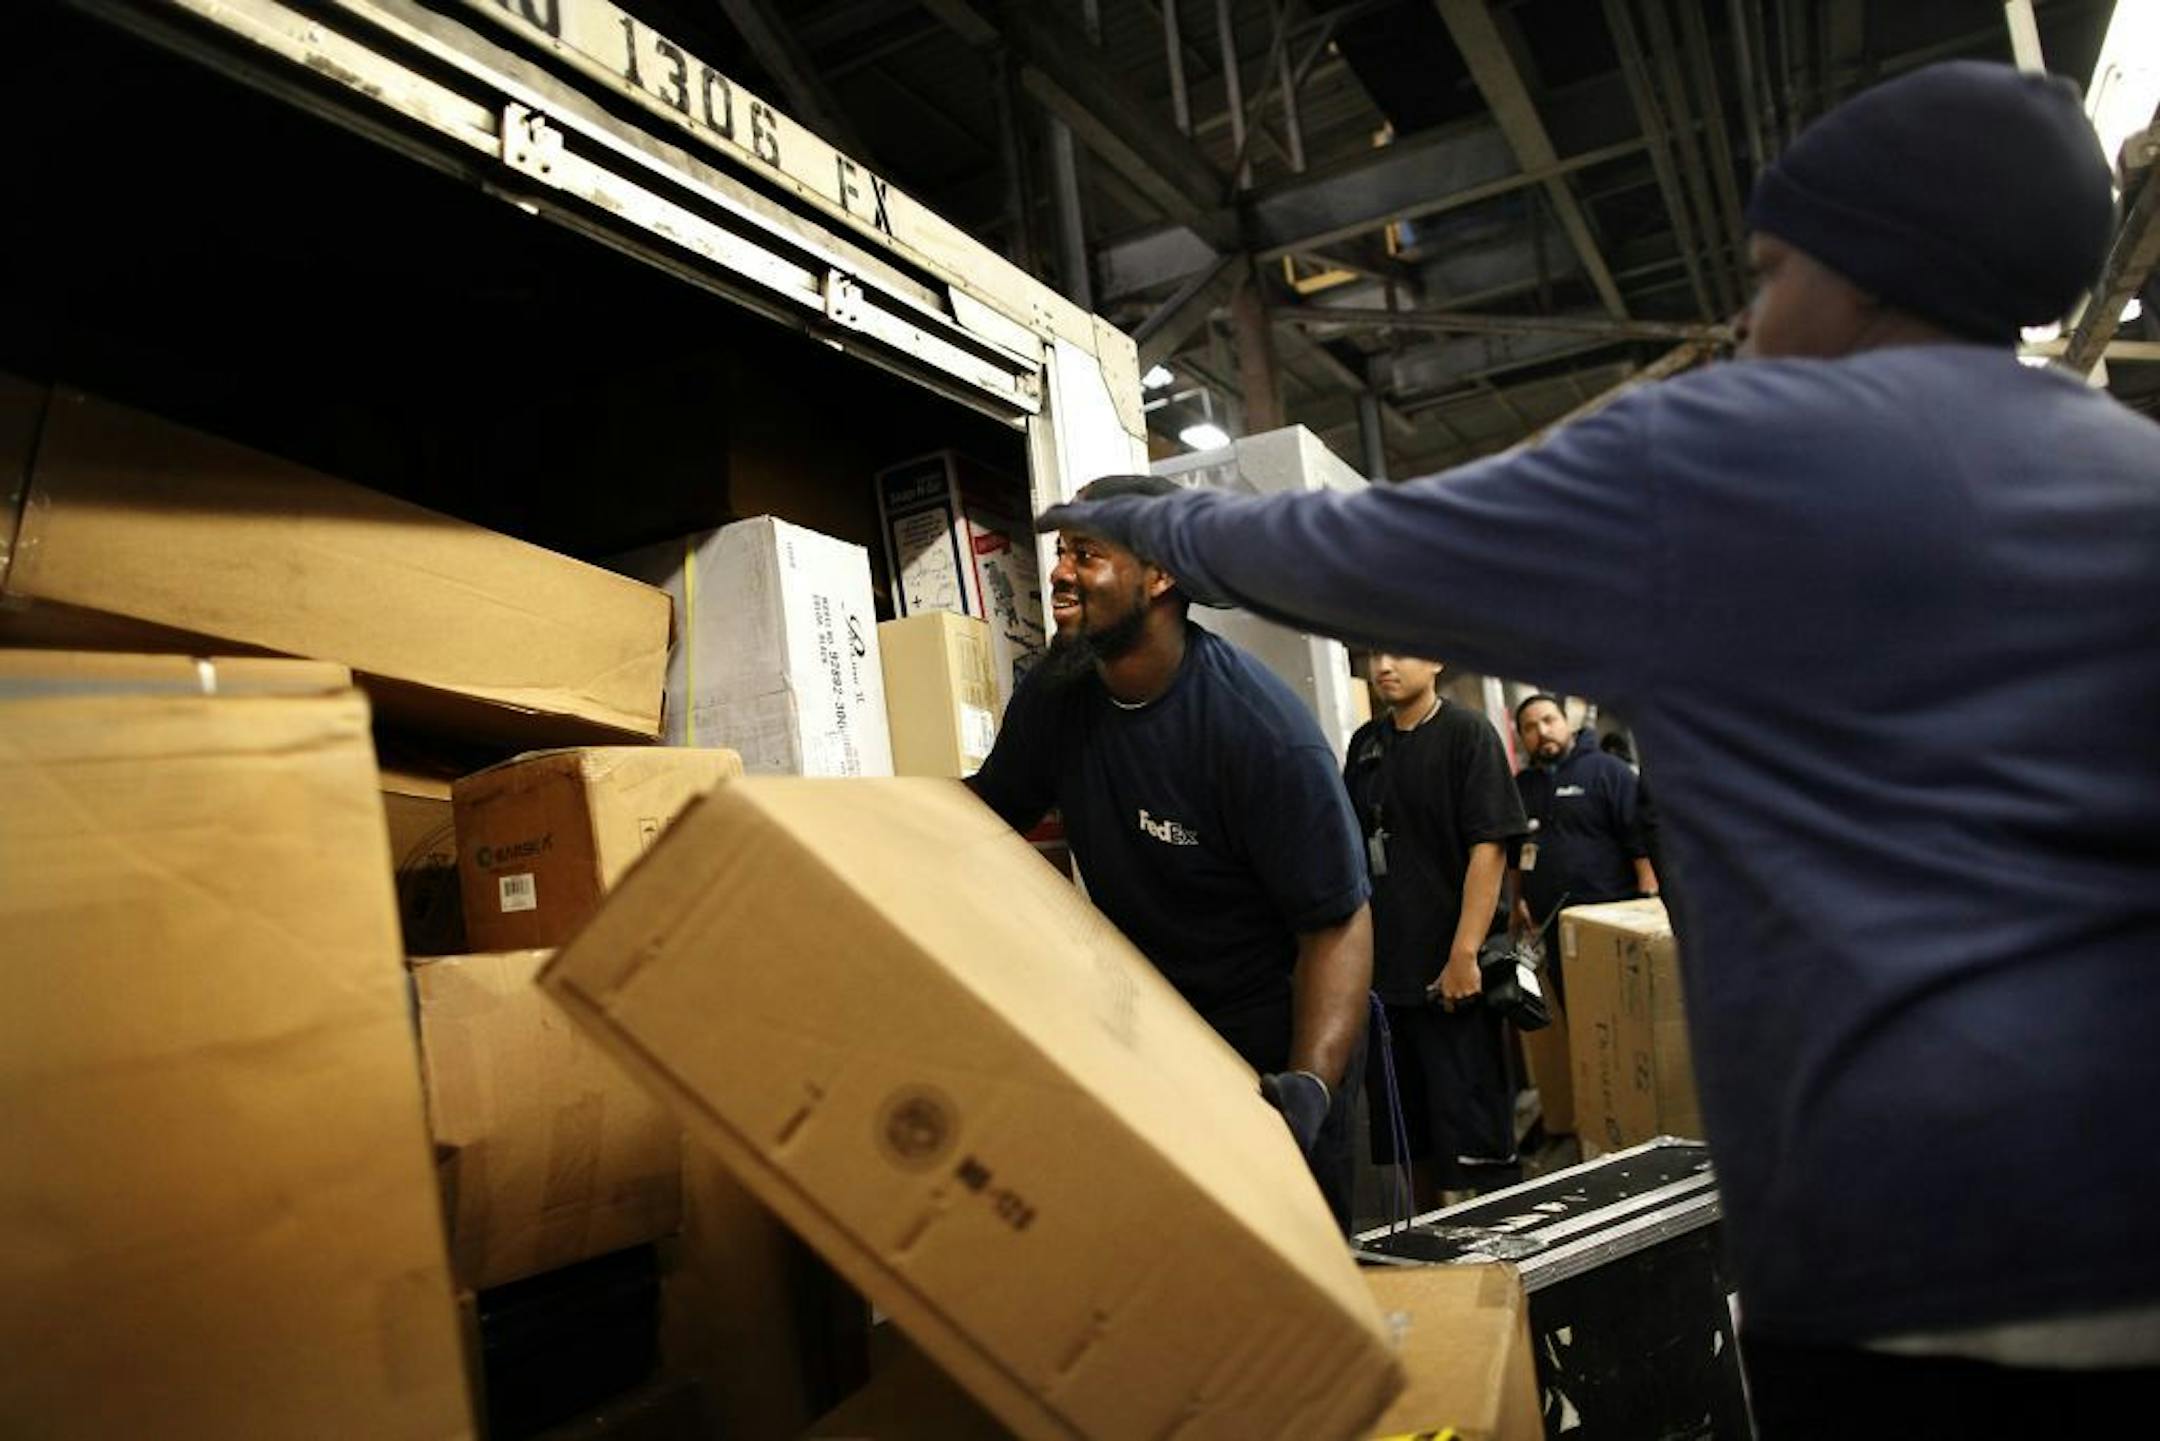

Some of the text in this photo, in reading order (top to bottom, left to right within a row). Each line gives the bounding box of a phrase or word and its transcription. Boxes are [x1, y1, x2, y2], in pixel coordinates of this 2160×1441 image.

[620, 16, 894, 238] 1306 FX
[1138, 808, 1200, 846] FedEx
